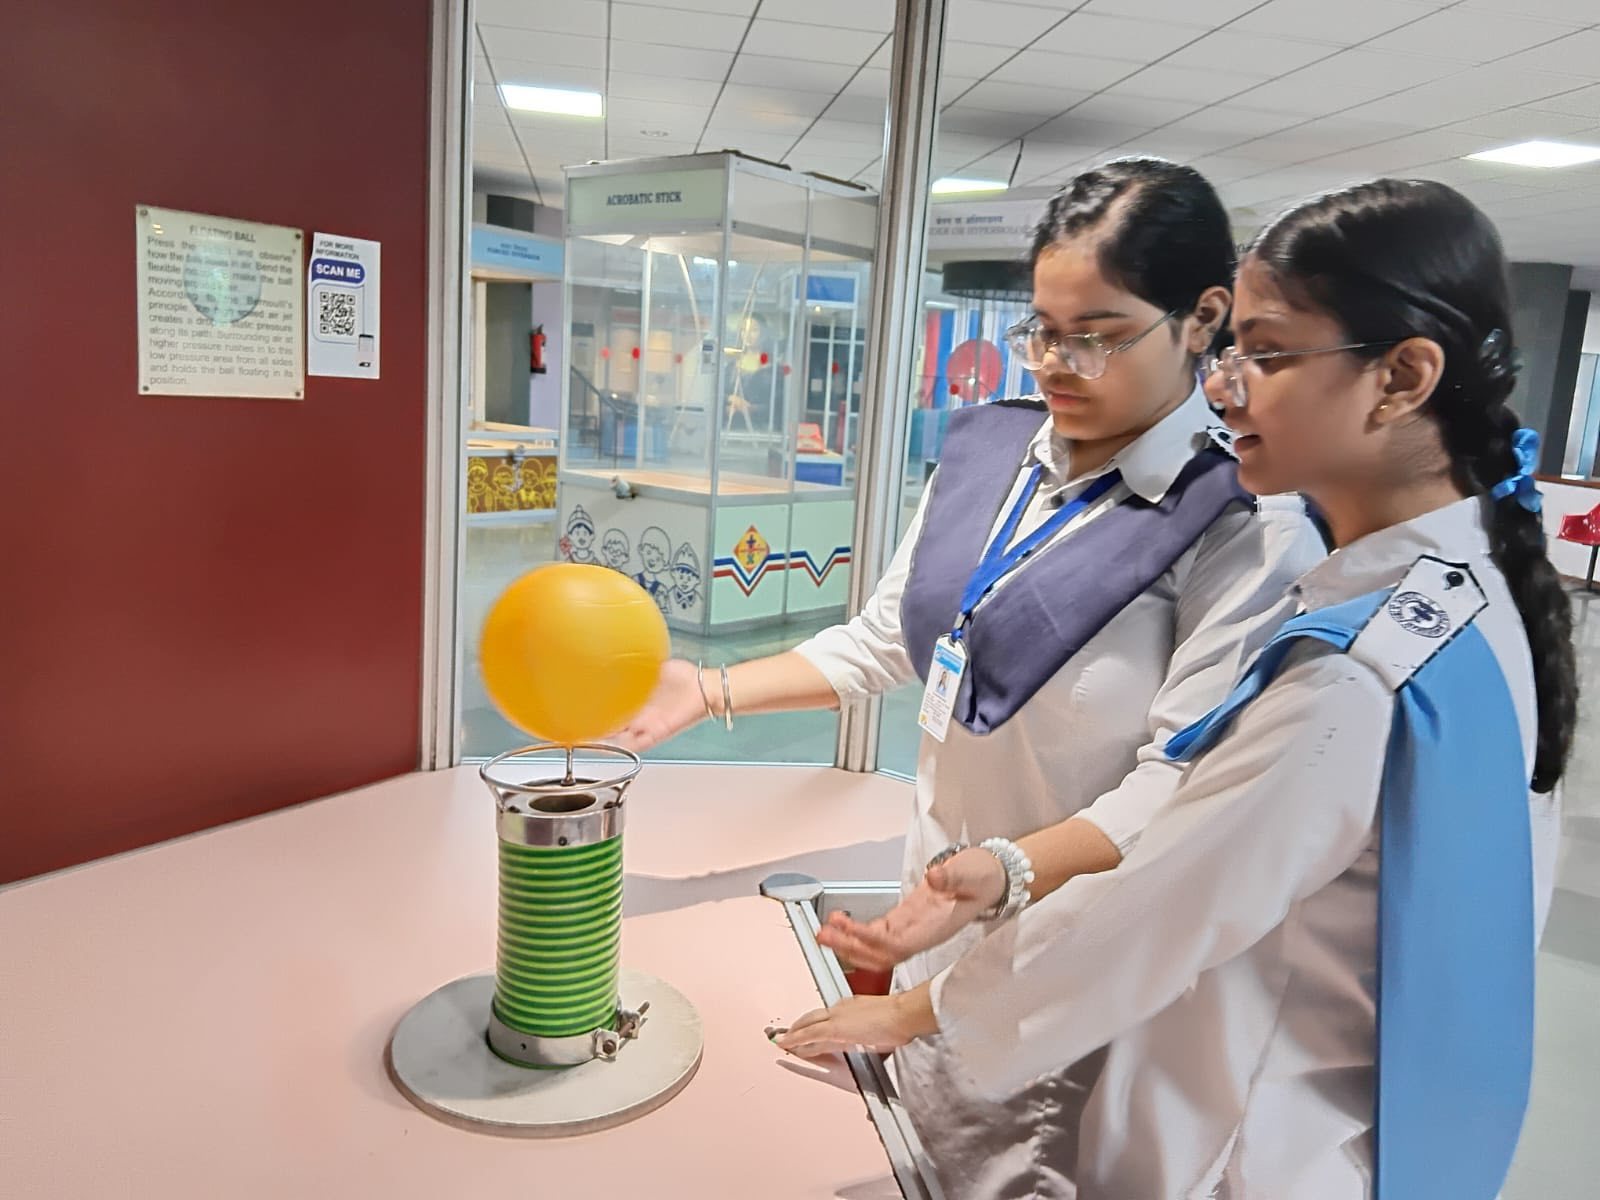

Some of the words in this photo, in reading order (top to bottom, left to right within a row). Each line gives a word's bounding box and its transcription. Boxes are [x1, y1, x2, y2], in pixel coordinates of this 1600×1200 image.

[607, 192, 653, 206] ACROBATIC
[655, 191, 682, 204] STICK
[234, 231, 256, 243] BALL
[147, 236, 175, 248] Press
[181, 239, 197, 250] the
[259, 251, 292, 263] observe
[315, 248, 360, 260] INFORMATION
[319, 241, 333, 249] FOR
[335, 242, 354, 251] MORE
[147, 249, 168, 260] how
[169, 250, 184, 262] the
[255, 261, 279, 273] Bend
[280, 263, 293, 275] the
[147, 261, 181, 275] flexible
[261, 274, 274, 284] the
[278, 276, 292, 286] ball
[316, 263, 344, 277] SCAN
[346, 267, 361, 279] ME
[148, 276, 182, 288] moving
[148, 288, 198, 302] Accordig
[246, 295, 293, 309] Benoulli's
[149, 314, 183, 324] creates
[187, 316, 193, 324] a
[256, 321, 292, 333] pressure
[268, 311, 279, 320] air
[282, 312, 293, 322] jet
[150, 326, 175, 337] along
[178, 327, 188, 337] its
[217, 330, 270, 344] Surrounding
[271, 334, 282, 343] air
[285, 335, 293, 344] at
[150, 338, 179, 350] higher
[182, 341, 222, 352] pressure
[225, 343, 255, 353] rushes
[257, 344, 266, 353] in
[268, 345, 276, 354] to
[278, 345, 293, 356] this
[150, 351, 165, 360] low
[168, 353, 210, 363] pressure
[213, 355, 233, 364] area
[236, 355, 256, 365] from
[258, 356, 268, 366] all
[271, 357, 293, 367] sides
[150, 364, 168, 373] and
[172, 364, 197, 374] holds
[200, 365, 216, 375] the
[219, 366, 235, 376] ball
[238, 366, 270, 378] floating
[272, 368, 280, 377] in
[284, 369, 293, 378] its
